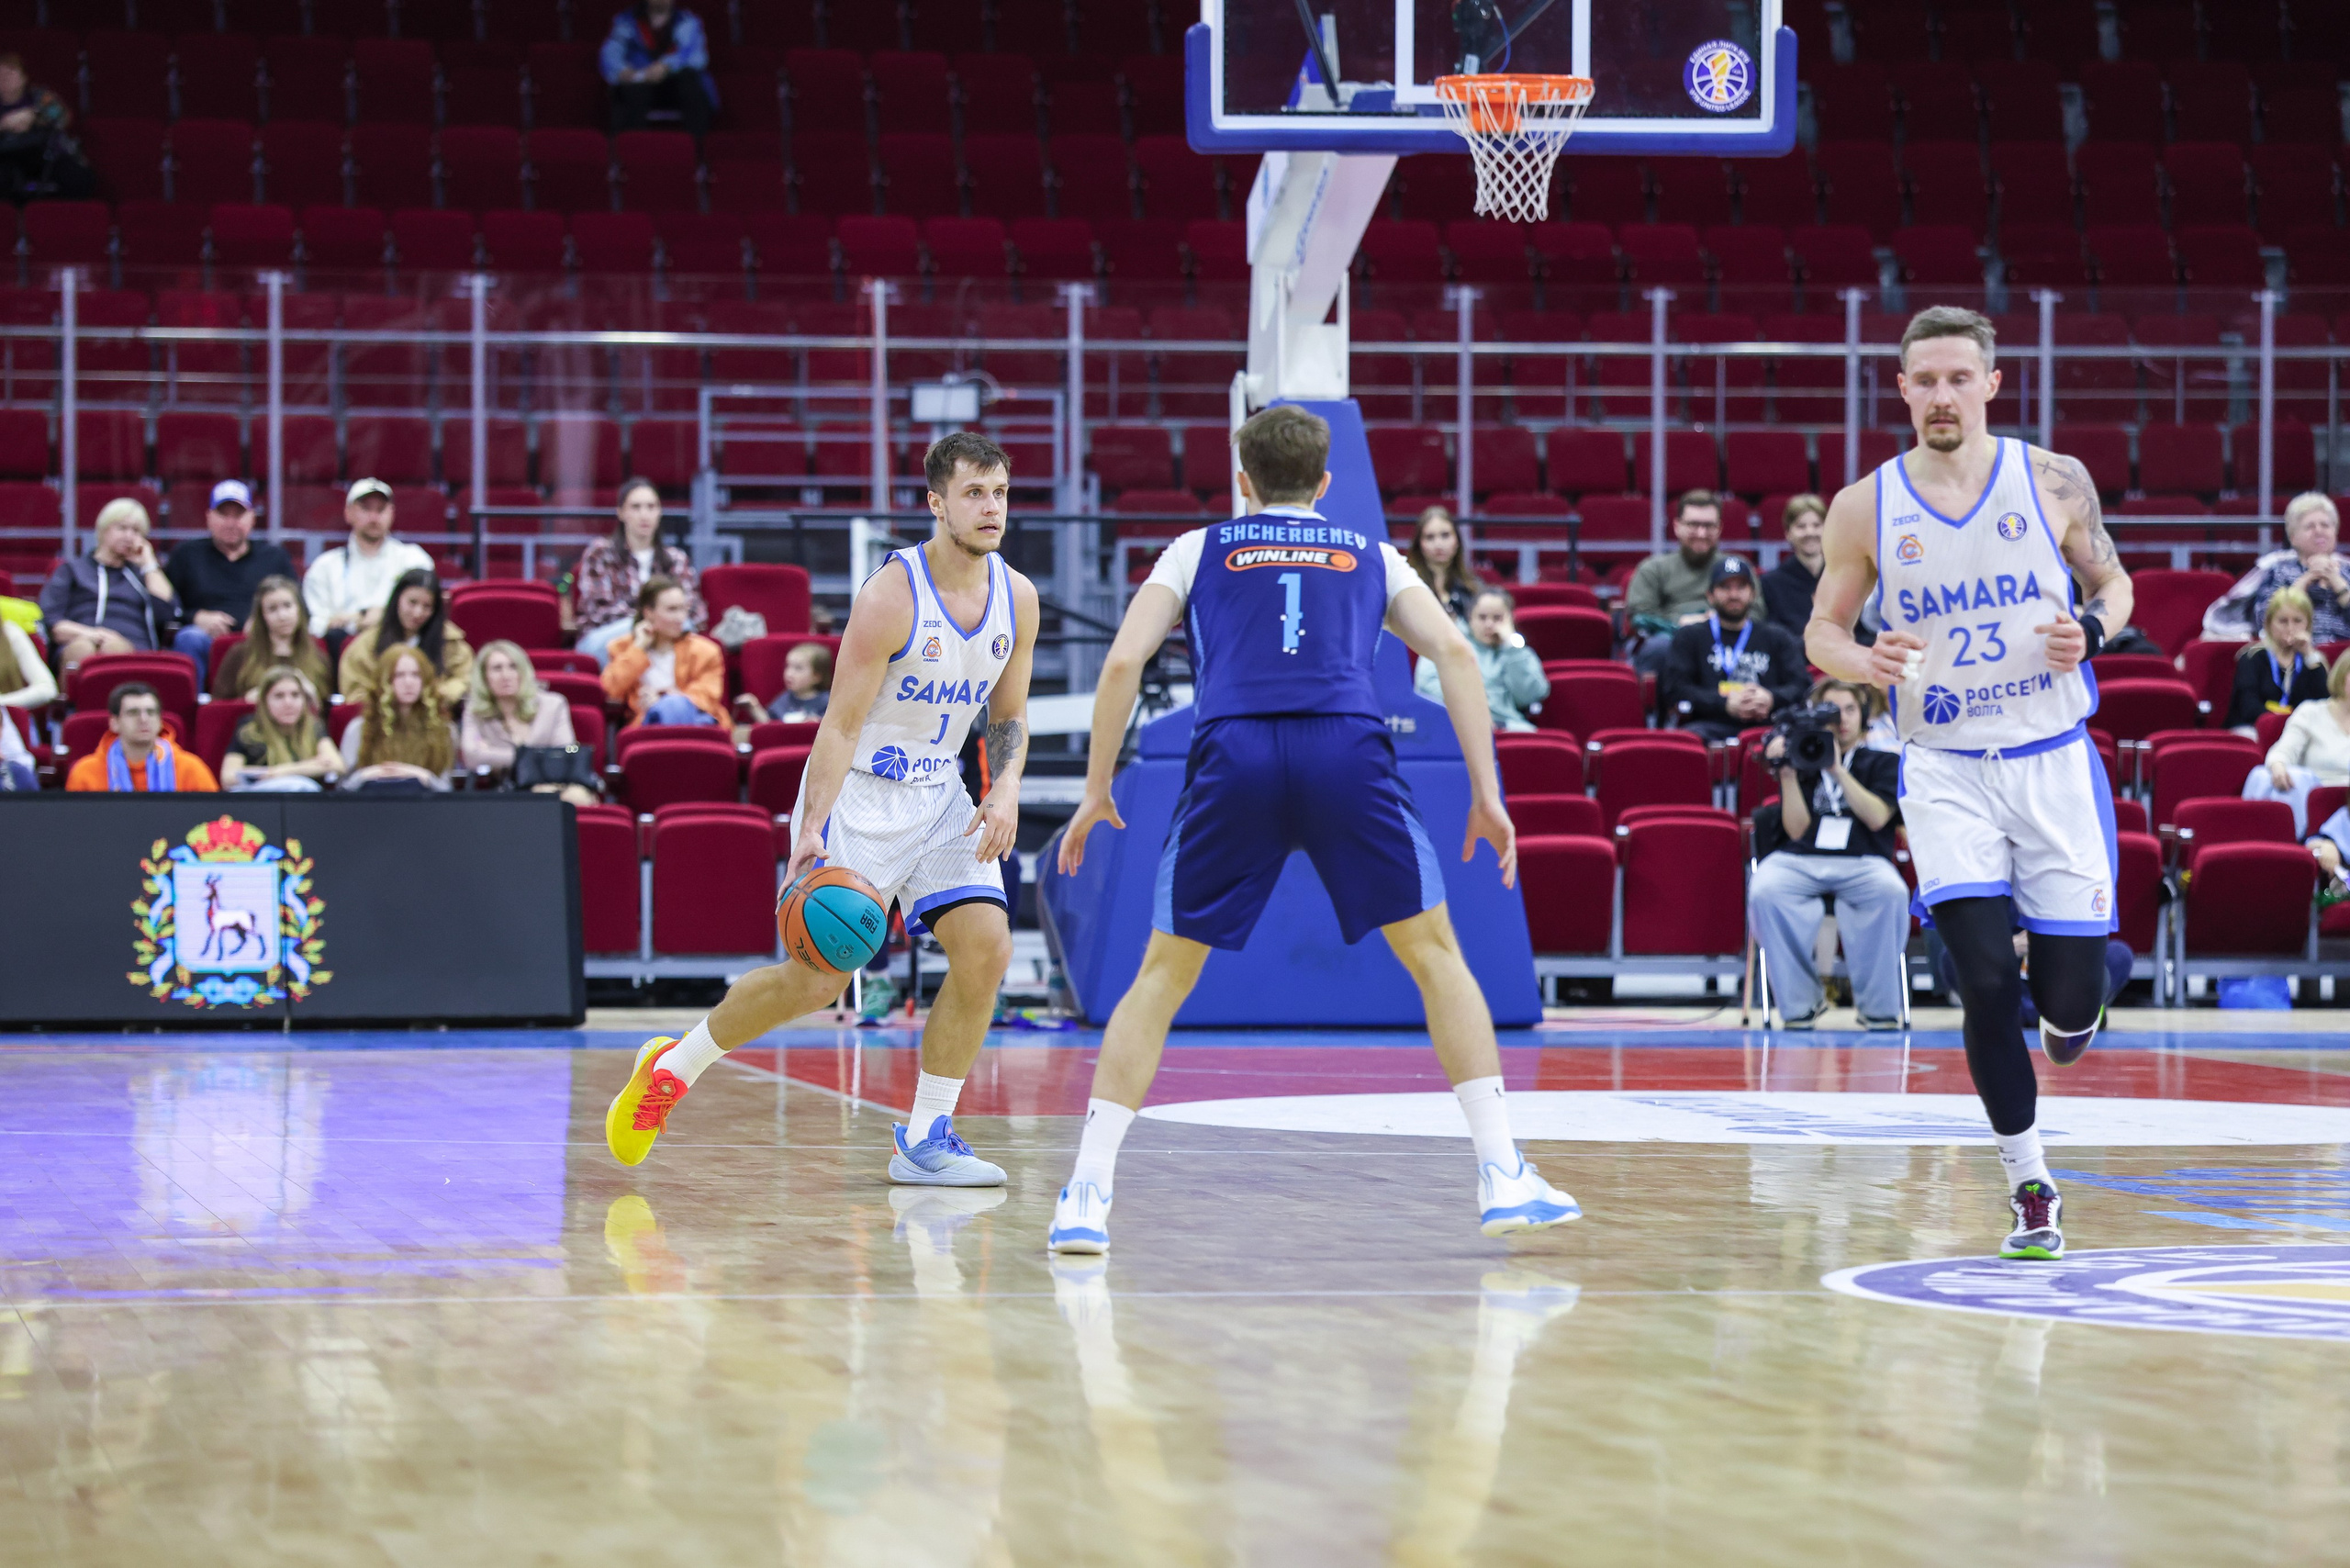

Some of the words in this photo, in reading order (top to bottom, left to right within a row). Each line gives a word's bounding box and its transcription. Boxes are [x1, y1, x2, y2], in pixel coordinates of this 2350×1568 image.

[1236, 549, 1329, 566] WINLINE
[1277, 573, 1304, 651] 1
[1898, 570, 2042, 624] SAMARA
[1948, 622, 2007, 667] 23
[896, 675, 990, 705] SAMAR
[1965, 672, 2053, 705] РОССЕТИ
[1967, 703, 2003, 718] ВОЛГА
[859, 913, 878, 935] FIBA
